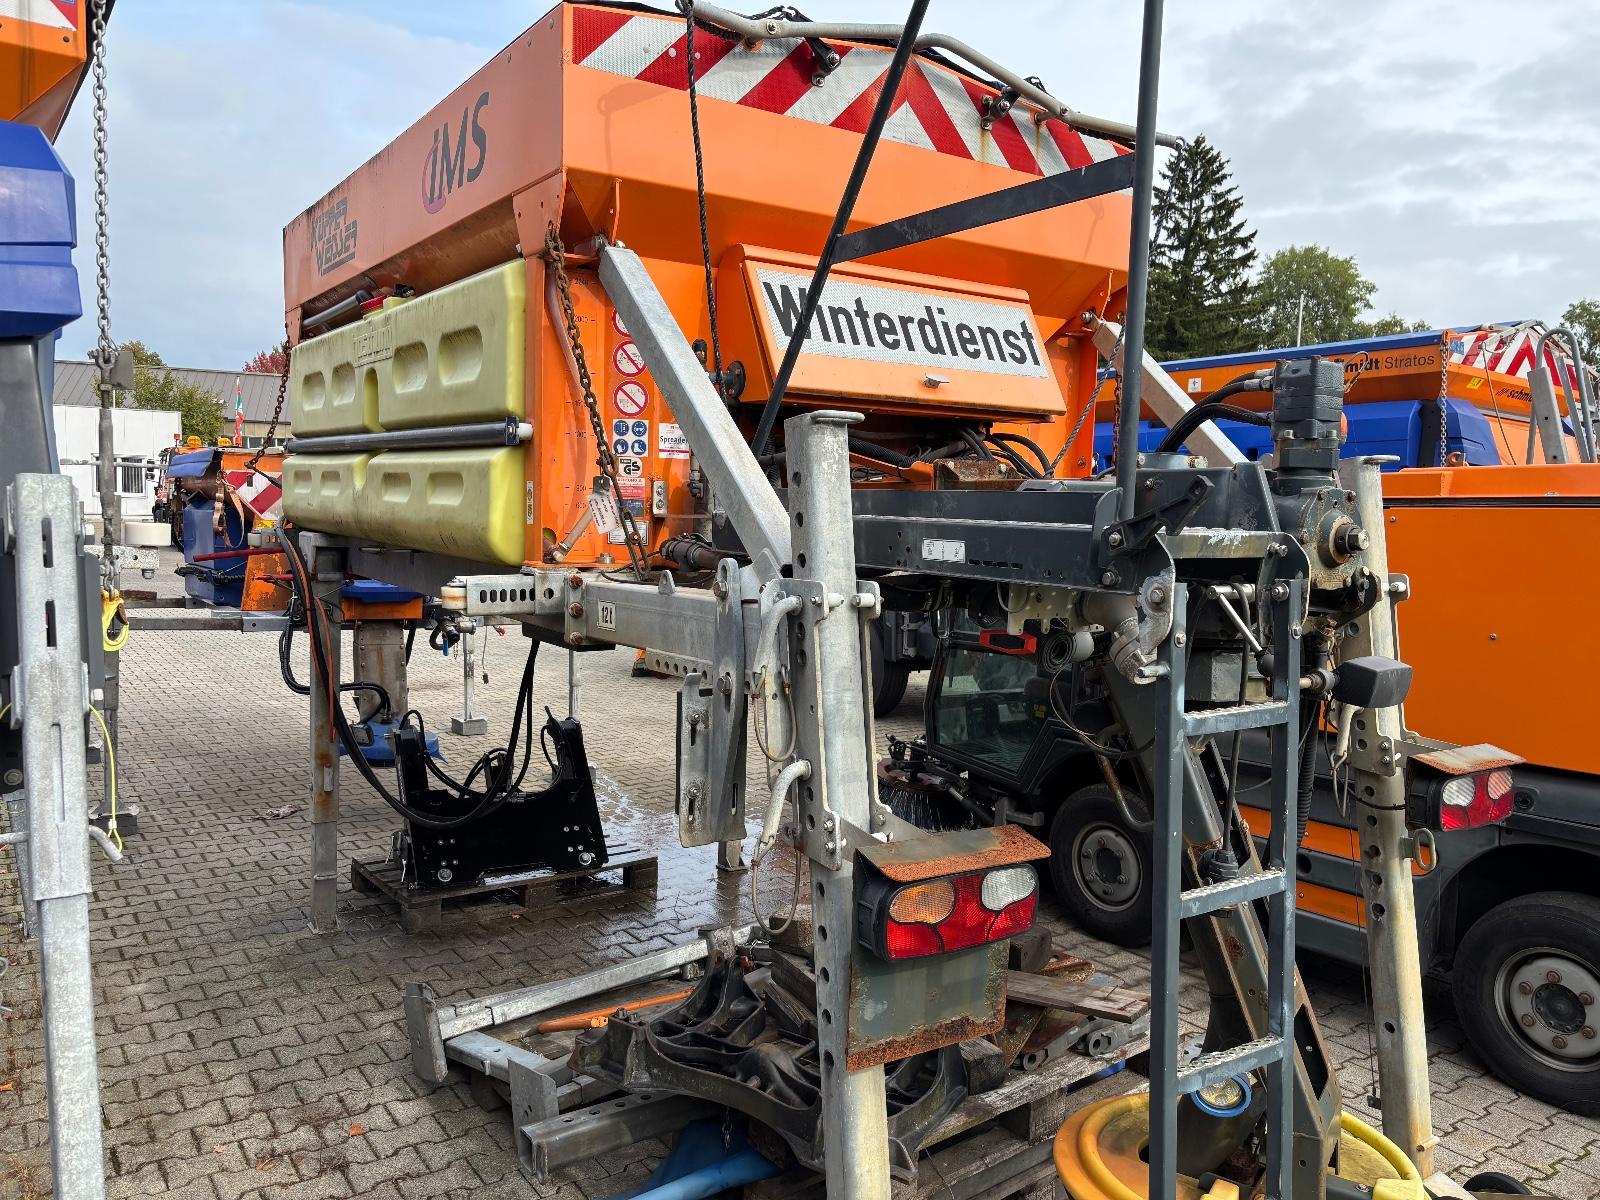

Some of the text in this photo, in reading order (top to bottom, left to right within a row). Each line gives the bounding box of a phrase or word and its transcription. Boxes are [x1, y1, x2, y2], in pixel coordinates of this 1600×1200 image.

[763, 282, 1040, 366] Winterdienst
[1385, 355, 1435, 370] Stratos
[623, 461, 641, 475] GS
